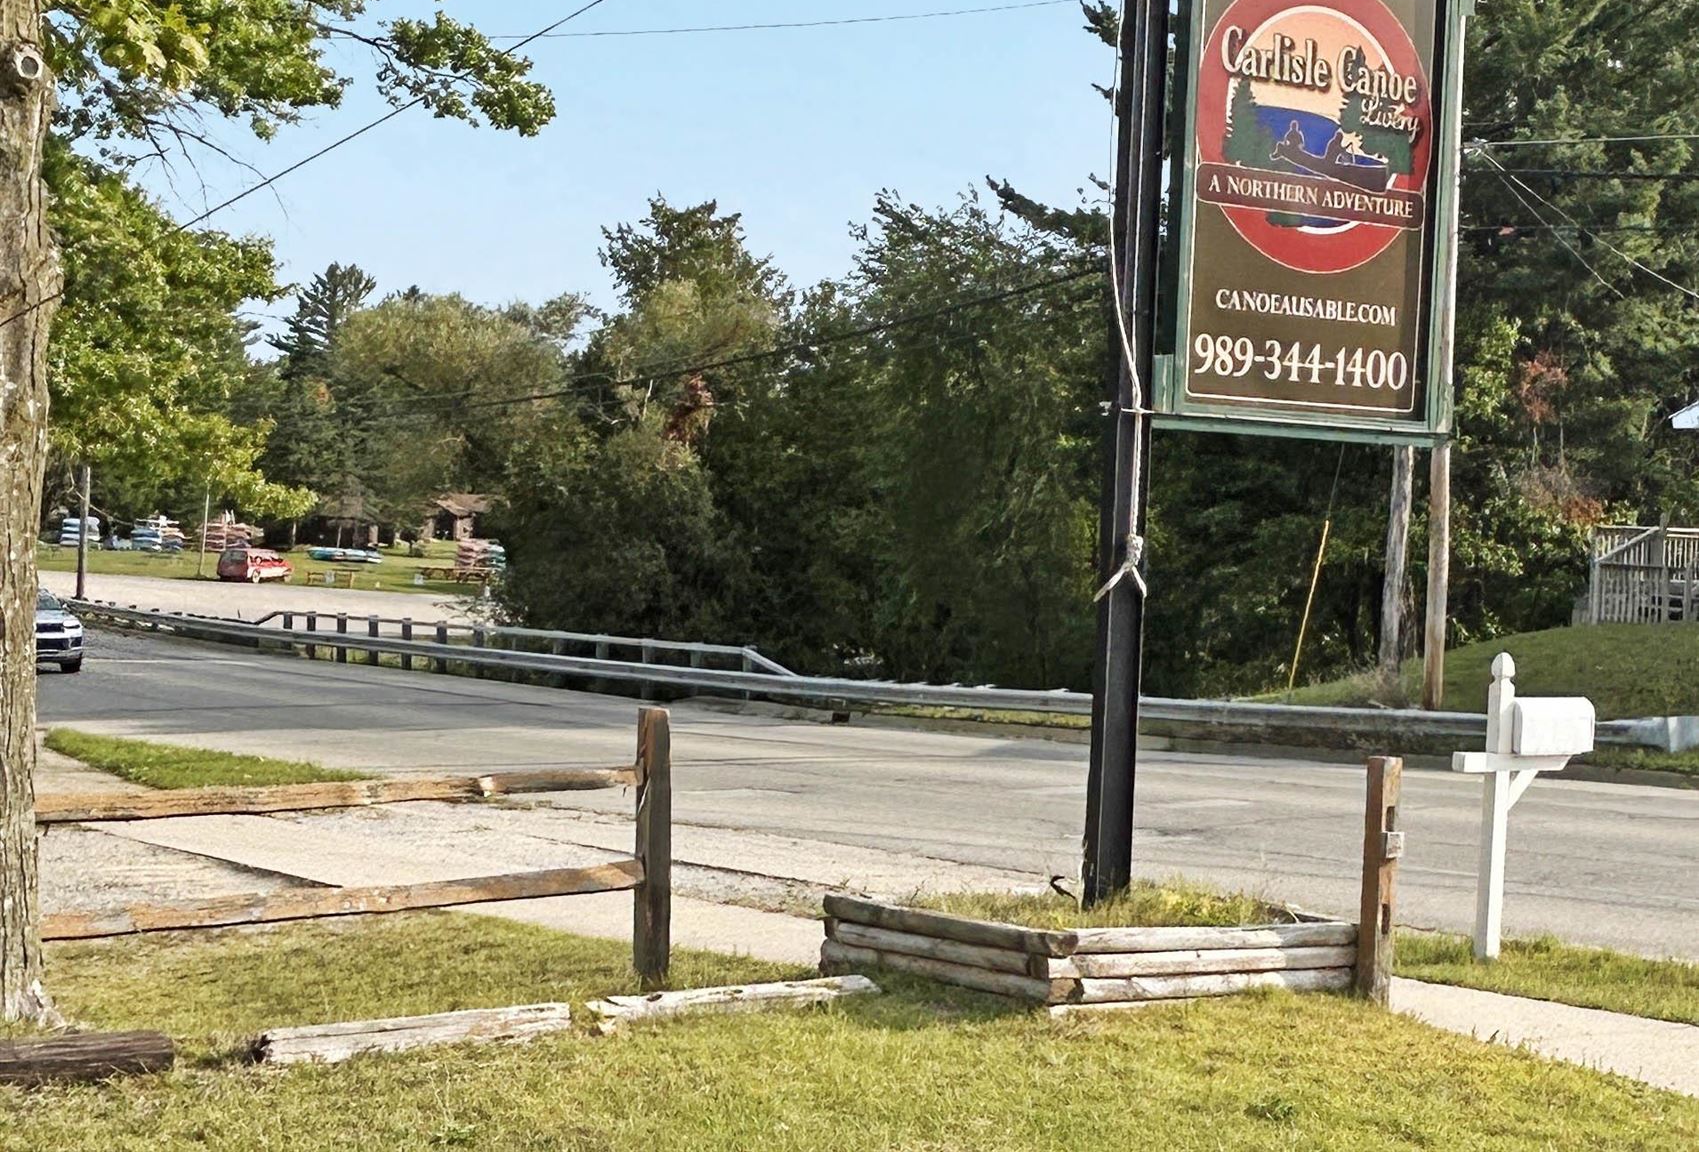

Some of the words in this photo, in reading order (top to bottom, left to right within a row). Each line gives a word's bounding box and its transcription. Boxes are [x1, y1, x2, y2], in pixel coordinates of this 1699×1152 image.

[1221, 25, 1328, 87] Carlisle
[1337, 45, 1417, 103] Canoe
[1360, 98, 1420, 143] Livery
[1209, 174, 1221, 193] A
[1227, 176, 1318, 206] NORTHERN
[1321, 191, 1413, 218] ADVENTURE
[1215, 289, 1396, 326] CANOEAUSABLE.COM
[1194, 333, 1407, 390] 989-344-1400
